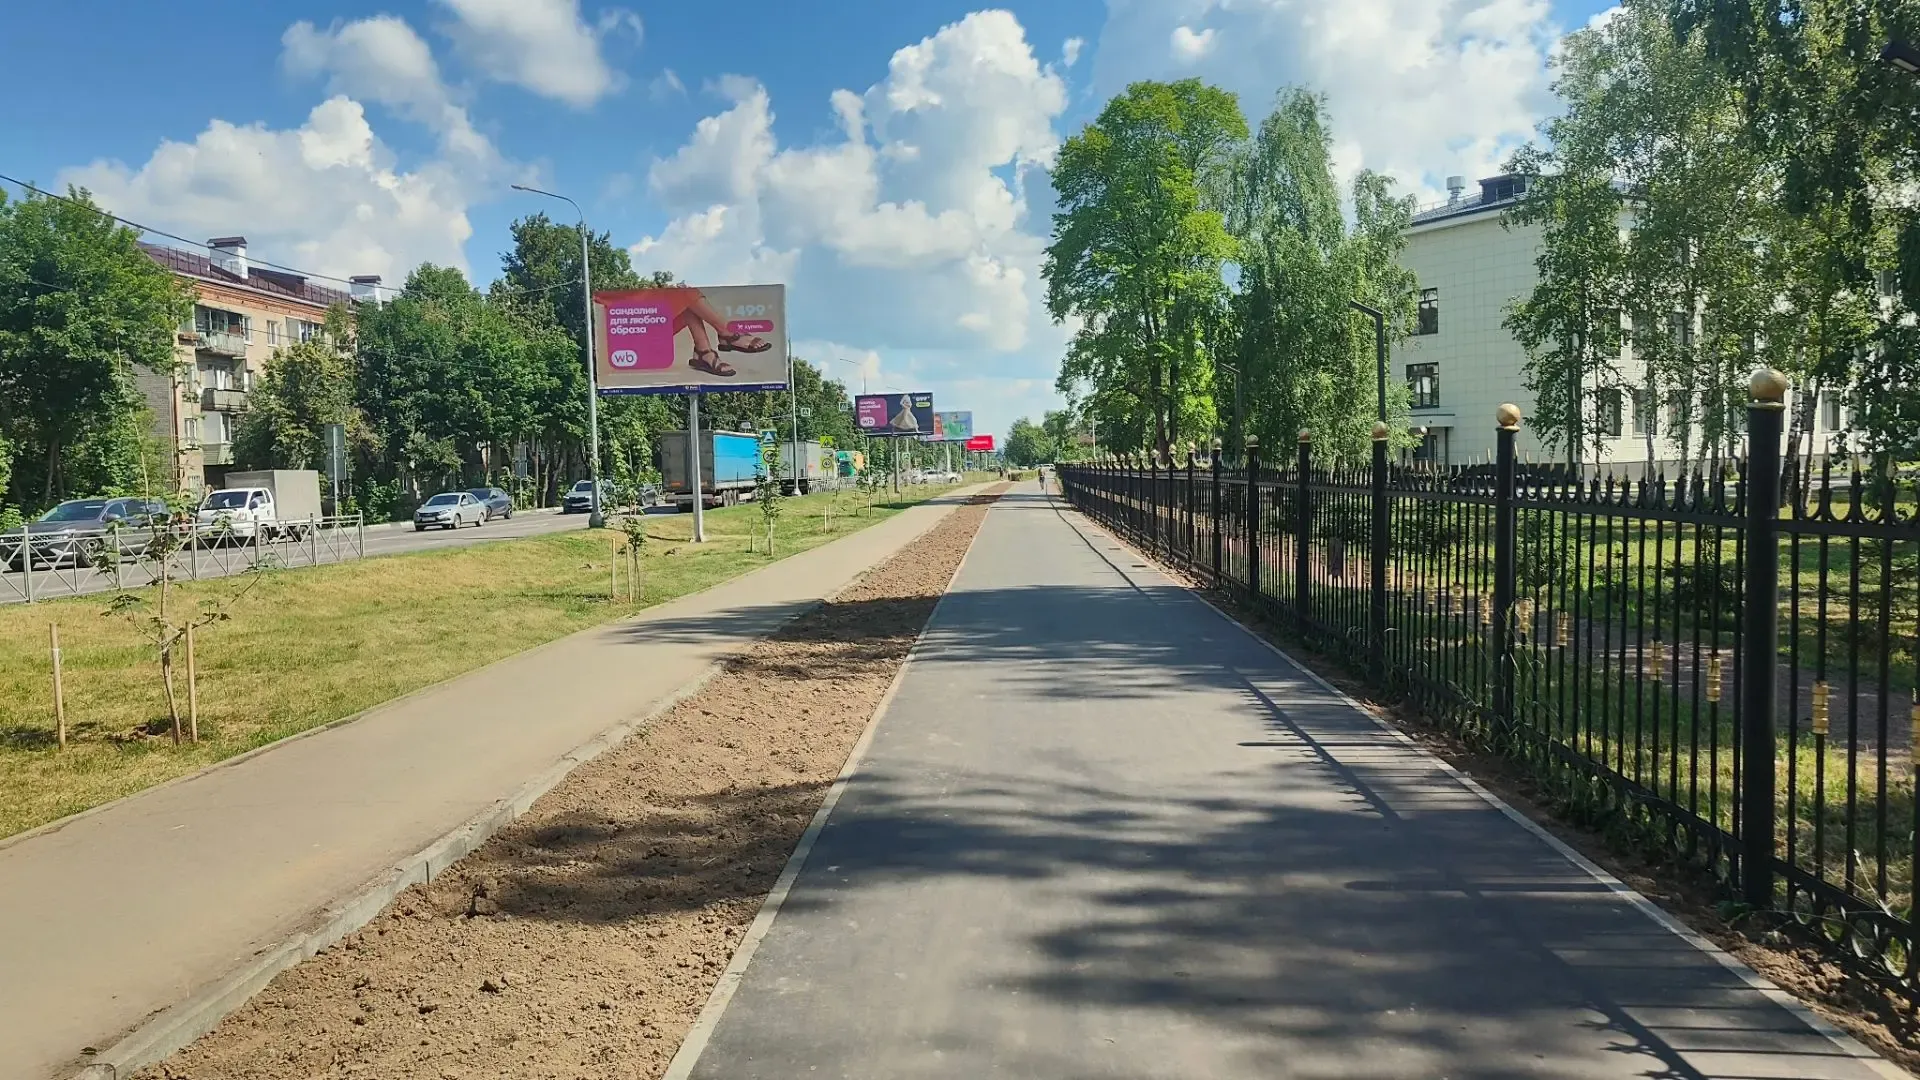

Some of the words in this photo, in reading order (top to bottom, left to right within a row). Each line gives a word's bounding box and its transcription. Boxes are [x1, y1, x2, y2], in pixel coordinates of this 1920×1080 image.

[630, 315, 667, 324] любого
[610, 325, 647, 335] образа
[614, 351, 634, 363] wb
